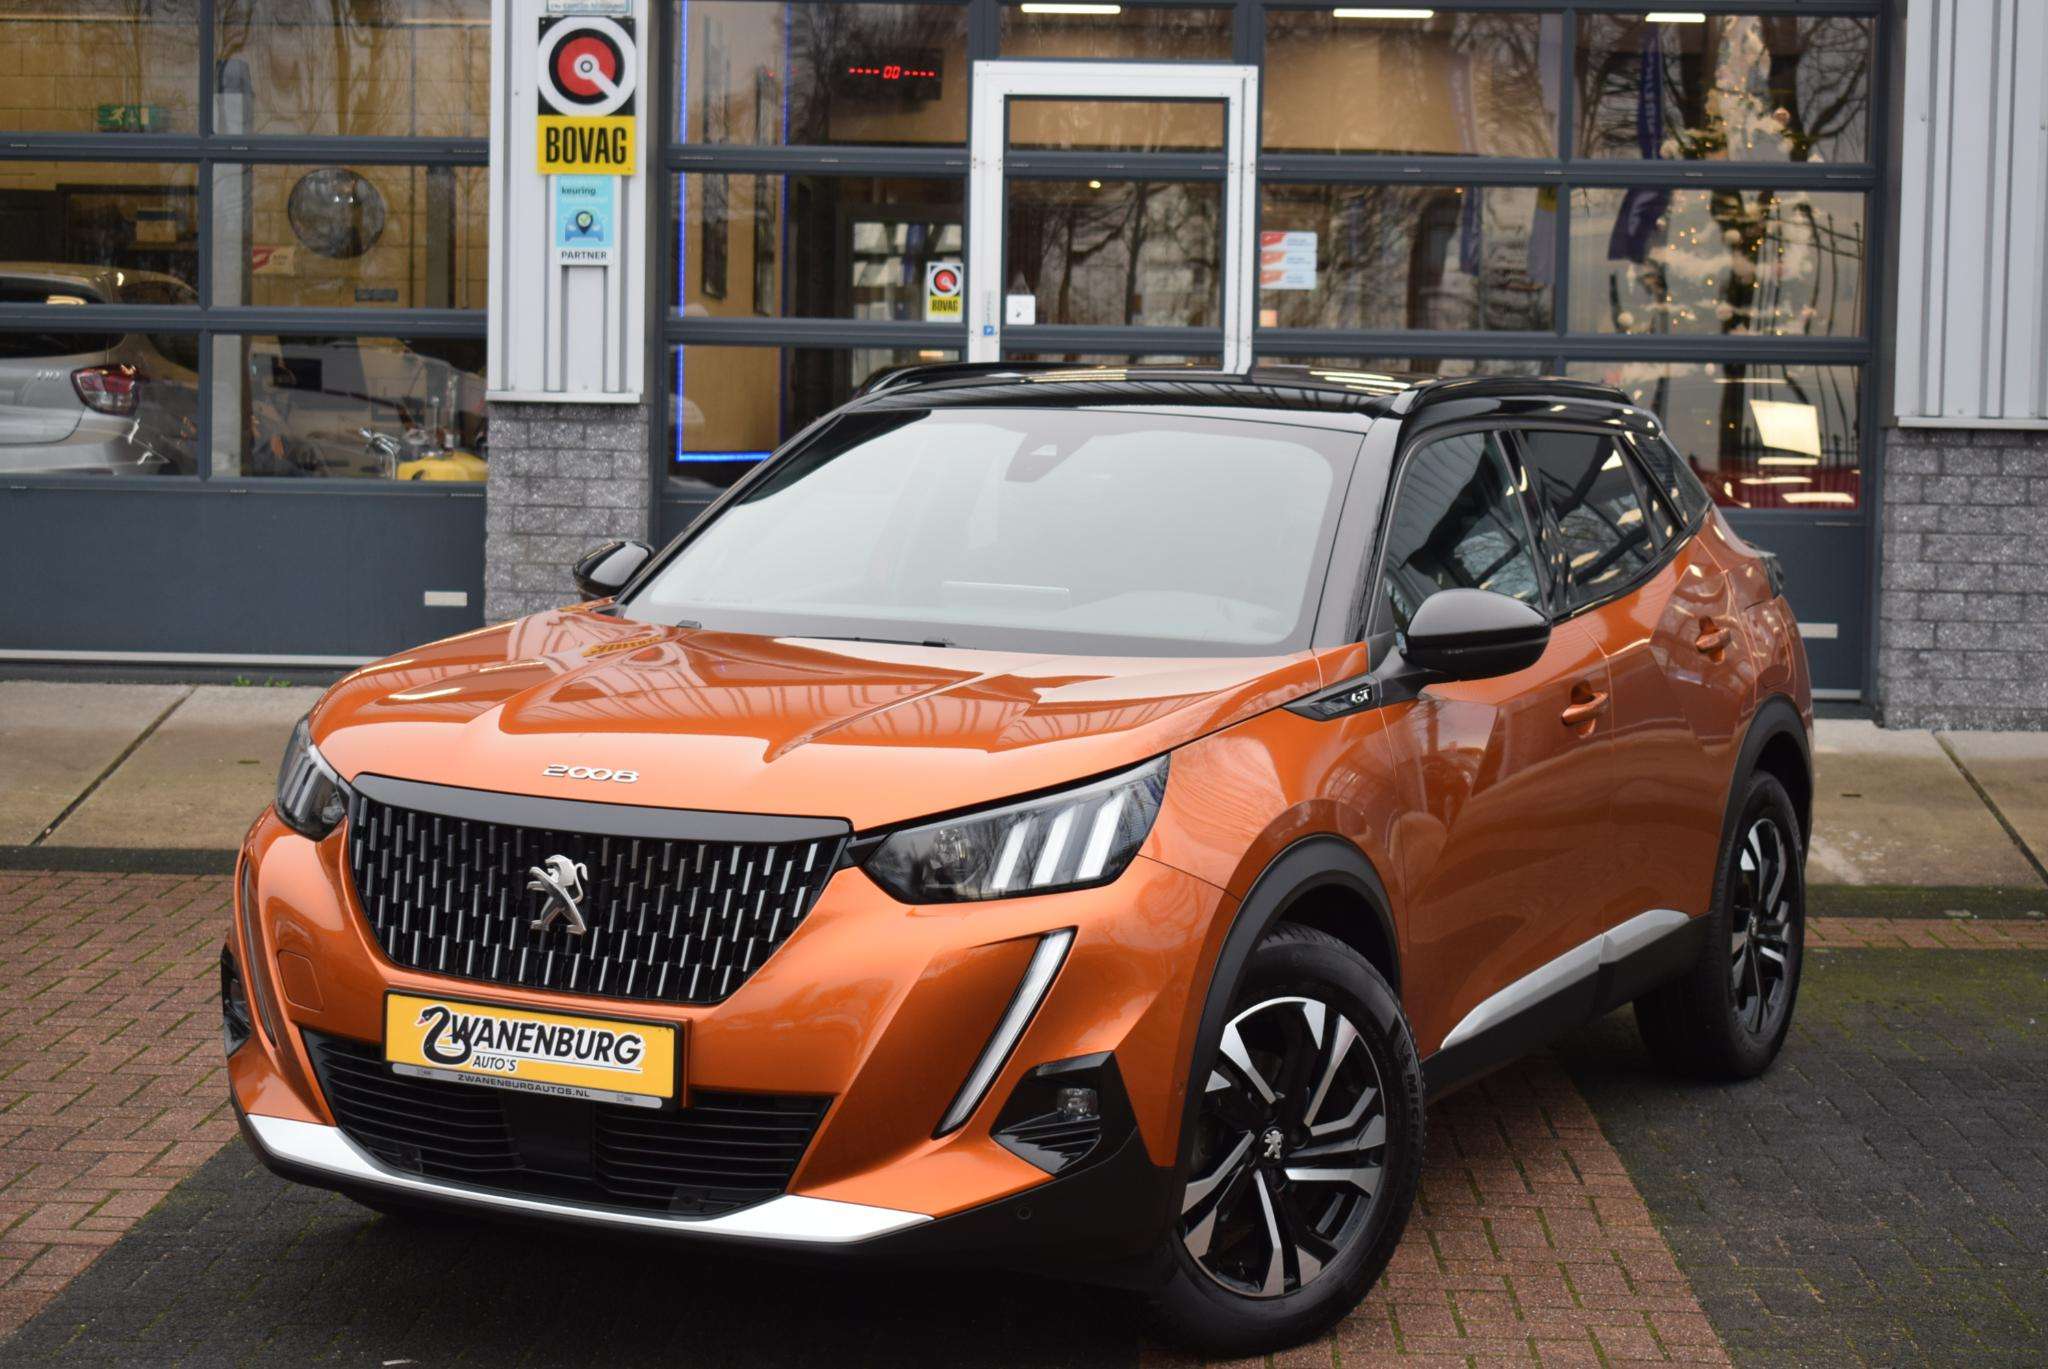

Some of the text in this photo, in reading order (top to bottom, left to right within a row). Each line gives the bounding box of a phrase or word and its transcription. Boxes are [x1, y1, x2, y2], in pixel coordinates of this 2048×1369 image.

[546, 126, 627, 164] BOVAG
[561, 186, 597, 196] keuring
[561, 250, 607, 260] PARTNER
[1351, 689, 1370, 704] GT
[543, 763, 640, 784] 2008
[472, 1055, 517, 1072] AUTO'S
[457, 1073, 591, 1098] ZWANENBURGAUTOS.NL
